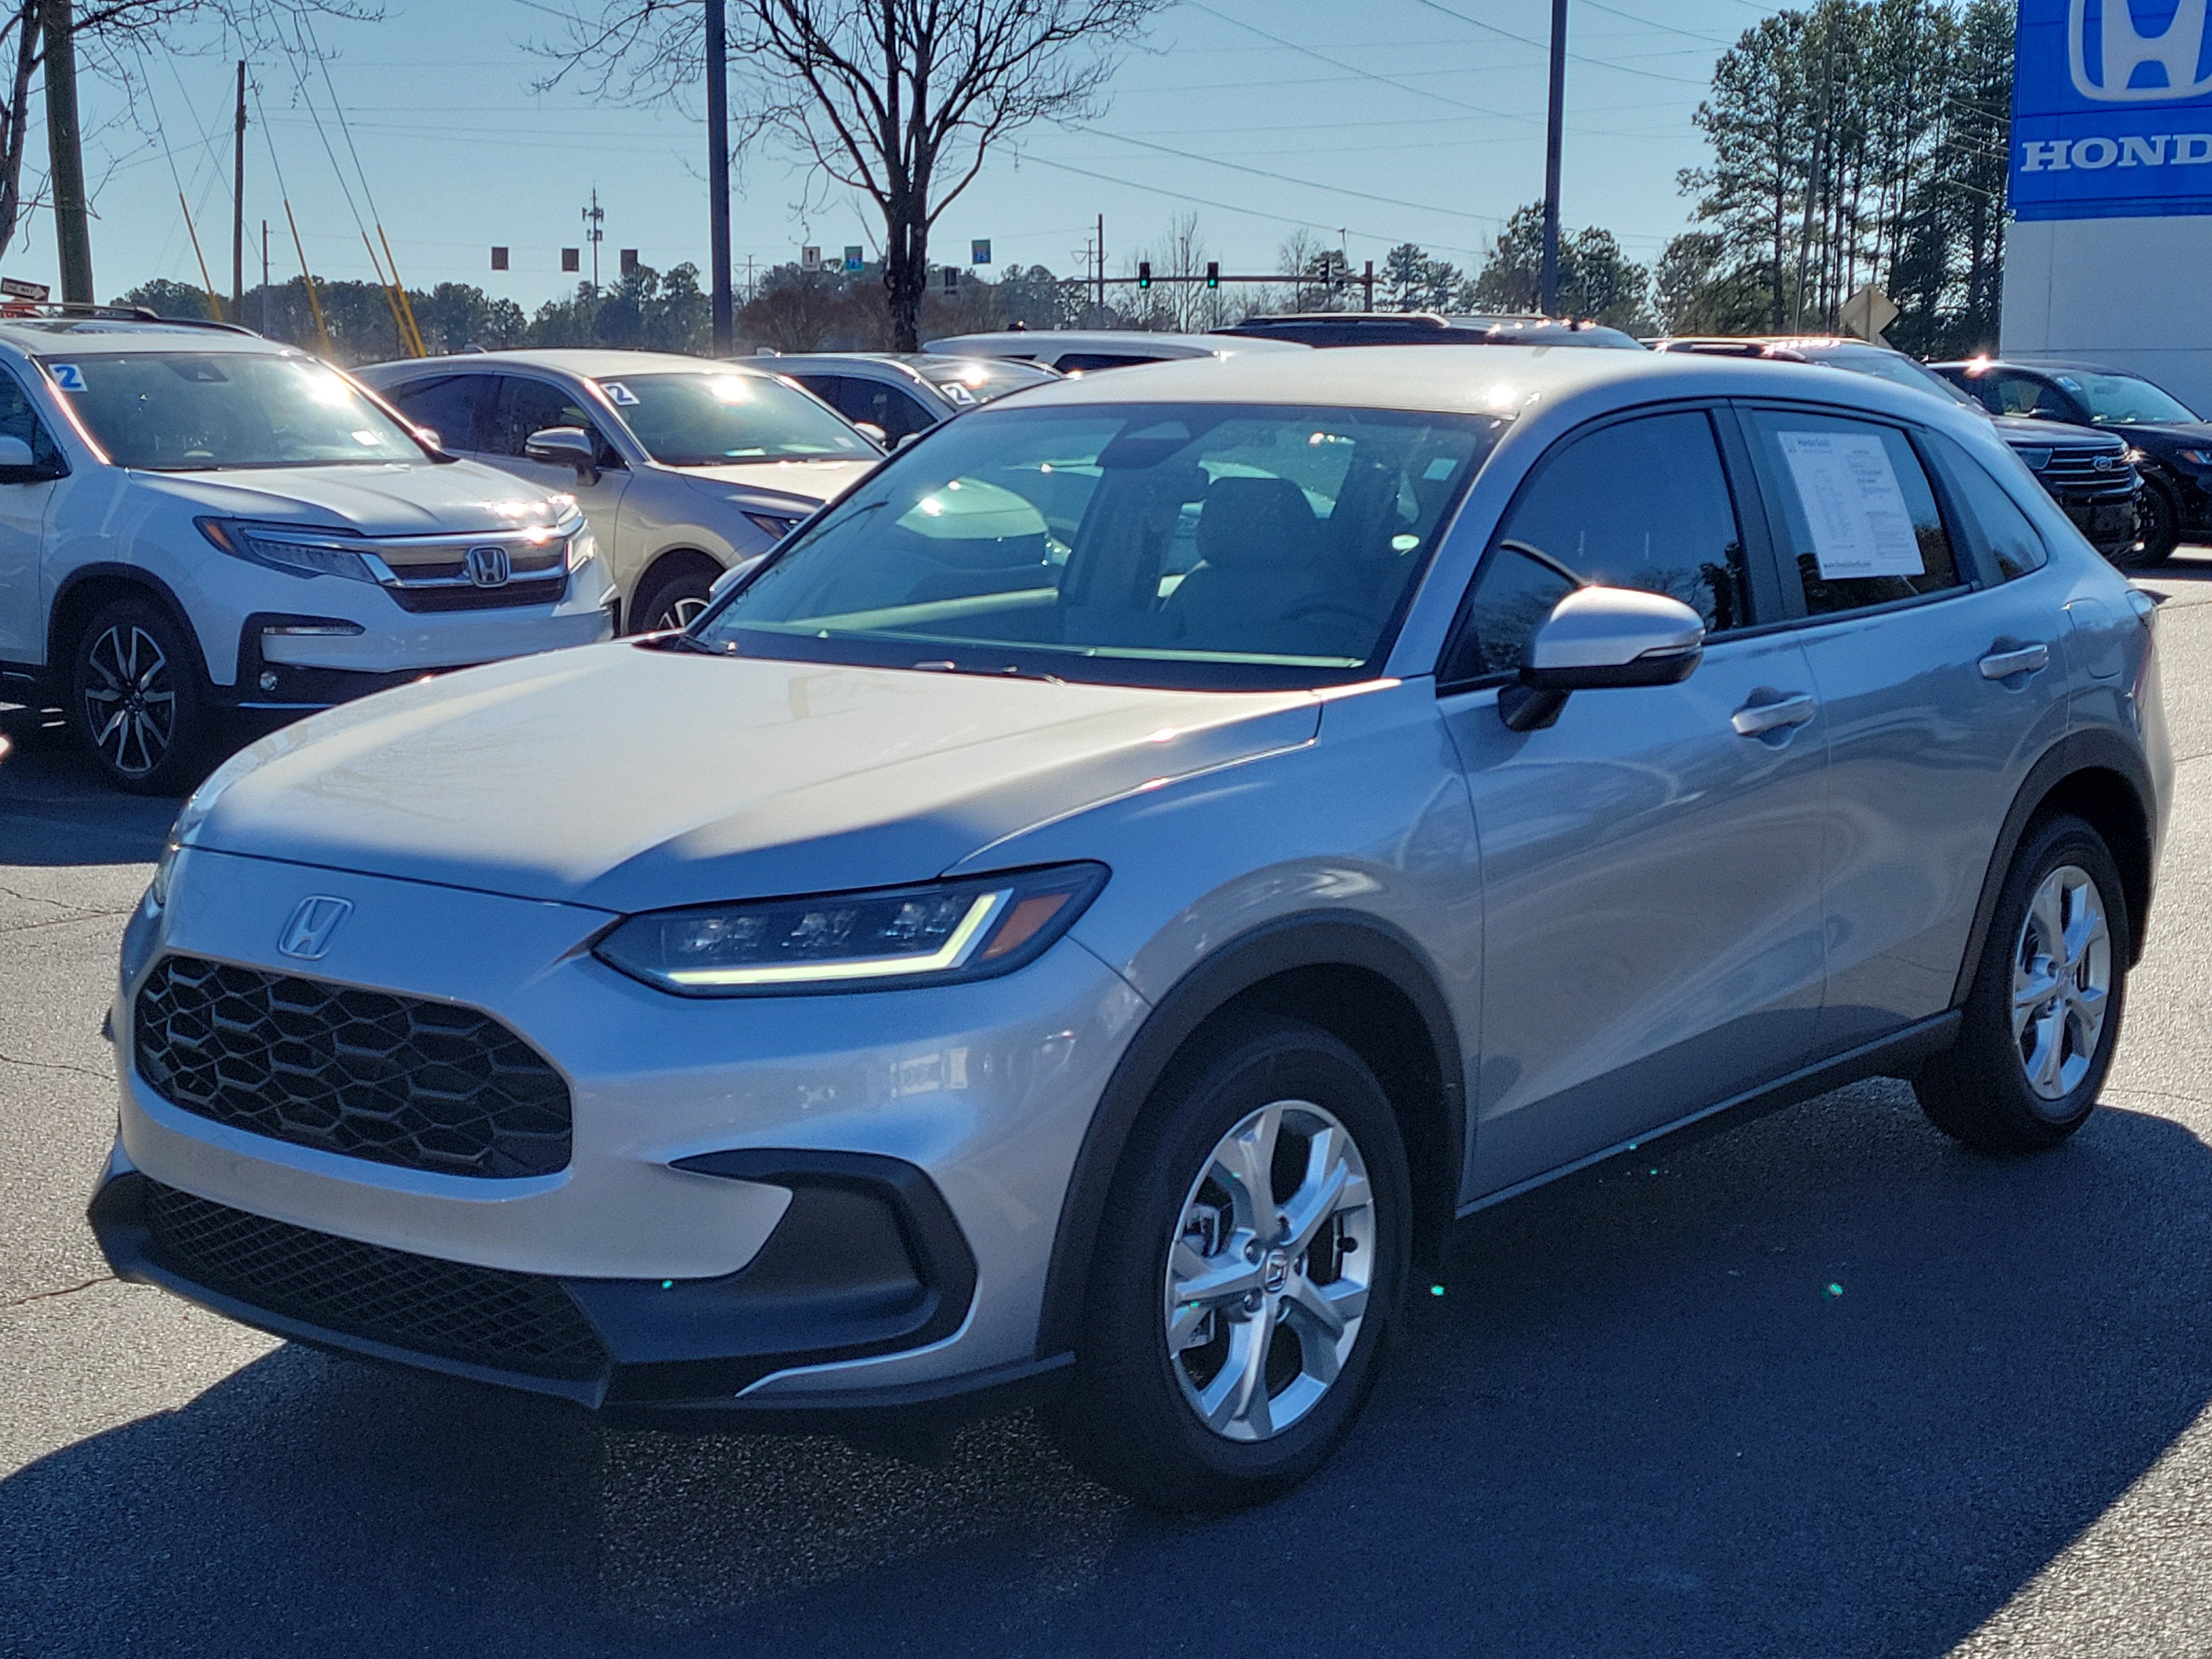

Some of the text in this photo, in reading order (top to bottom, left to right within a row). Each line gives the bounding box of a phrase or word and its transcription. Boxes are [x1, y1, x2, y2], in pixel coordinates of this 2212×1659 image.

[2021, 133, 2212, 172] HOND
[54, 366, 82, 388] 2
[605, 385, 633, 402] 2
[946, 386, 970, 400] 2
